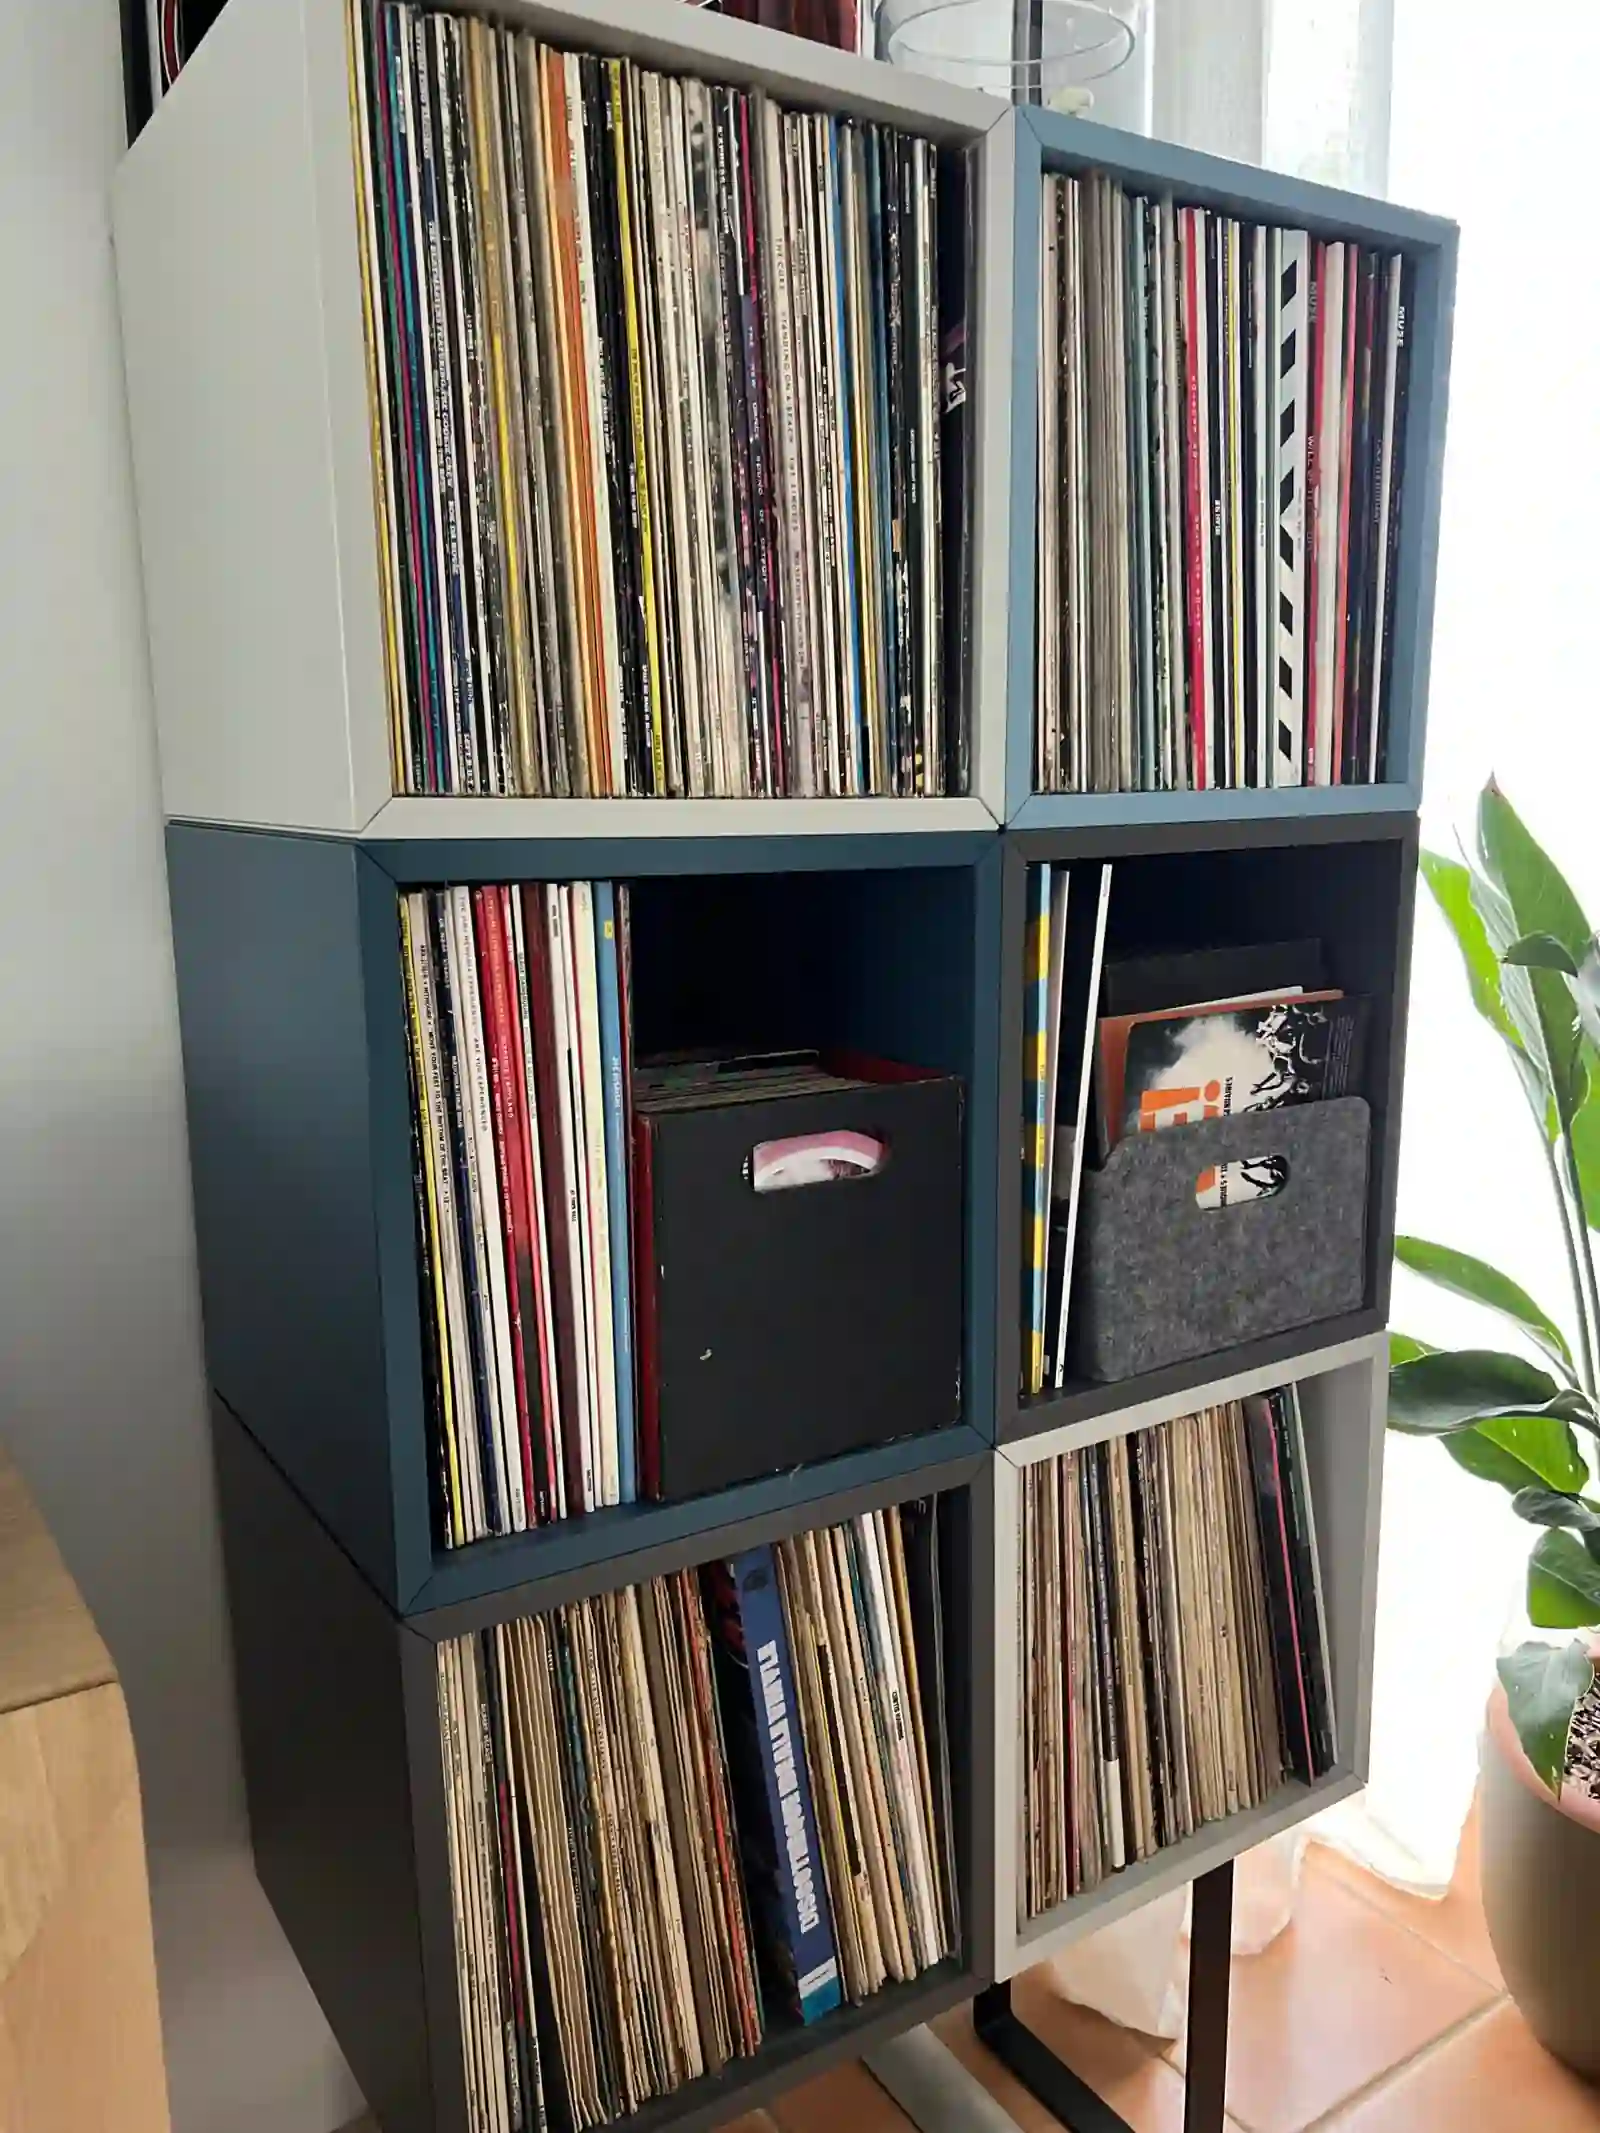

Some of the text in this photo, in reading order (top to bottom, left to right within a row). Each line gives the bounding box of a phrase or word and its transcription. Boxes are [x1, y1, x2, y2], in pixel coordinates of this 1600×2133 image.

[1309, 281, 1317, 325] MUSE
[1397, 306, 1405, 347] MUSE
[429, 1052, 438, 1070] YOUR
[431, 1072, 440, 1088] FEET
[435, 1116, 445, 1140] RHYTHM
[439, 1166, 448, 1184] BEAT
[756, 1639, 789, 1726] VINYLE
[785, 1790, 821, 1934] DISCOTHÈQUE
